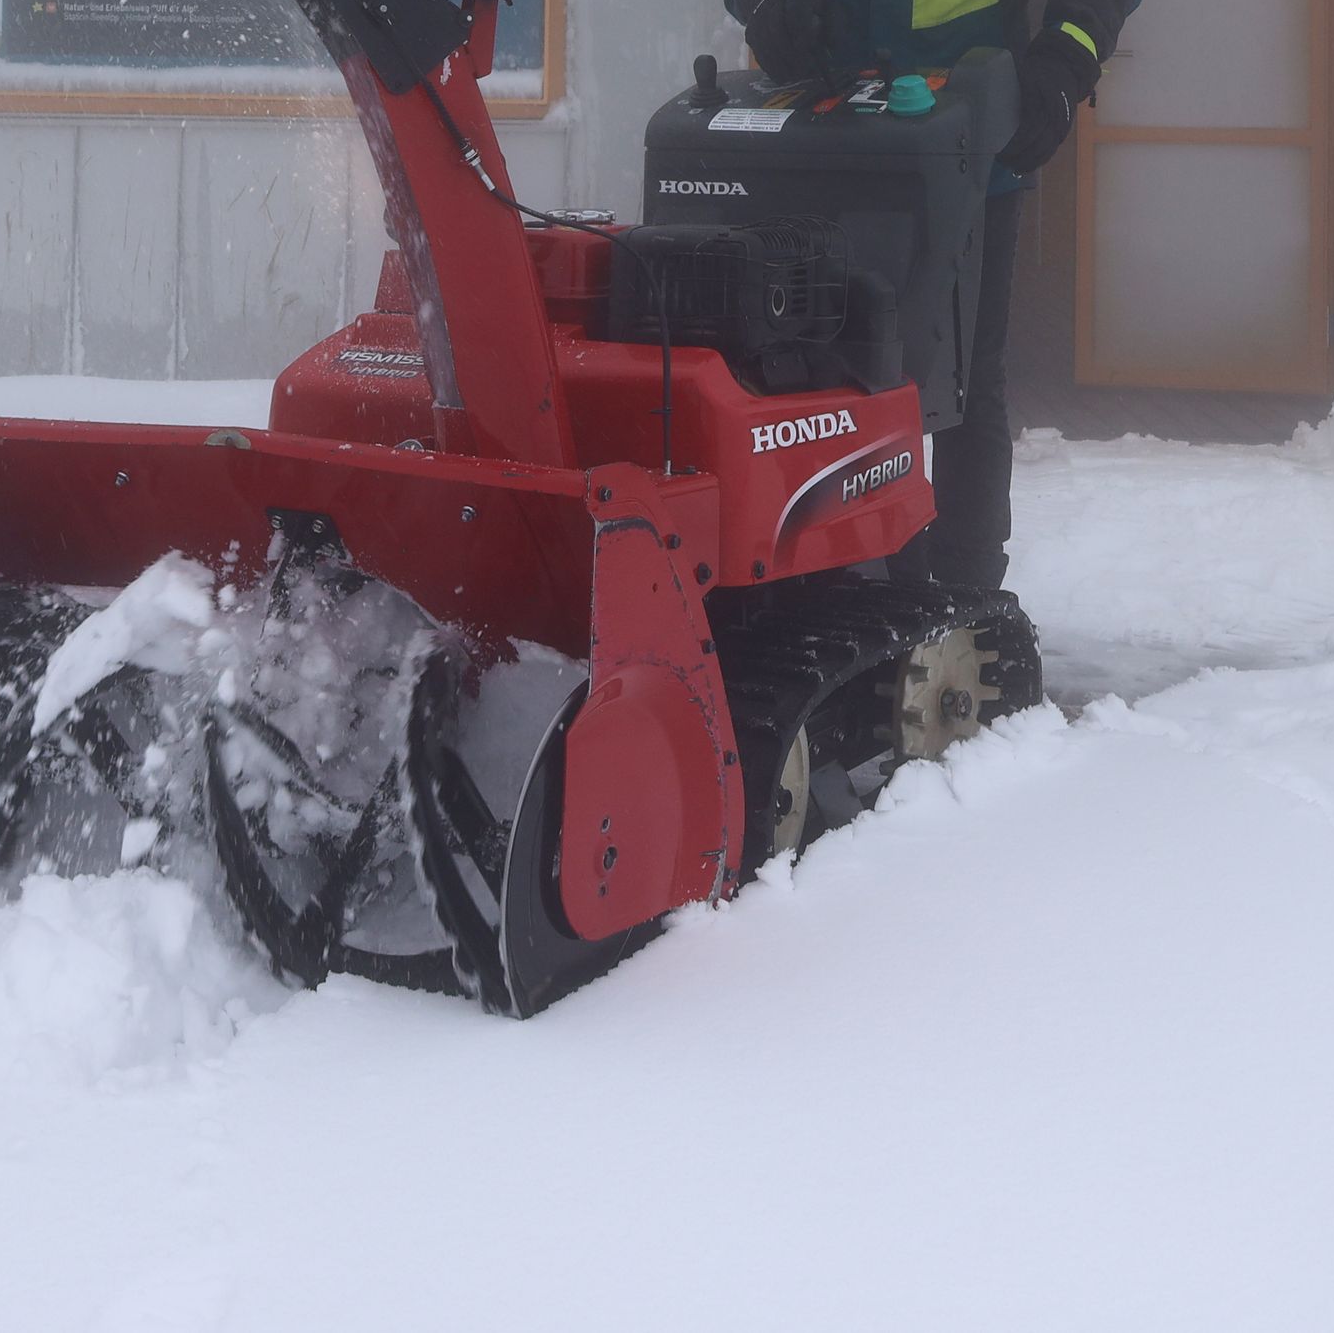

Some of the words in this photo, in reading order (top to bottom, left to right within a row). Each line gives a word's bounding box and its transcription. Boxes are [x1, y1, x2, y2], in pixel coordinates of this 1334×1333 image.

[659, 180, 749, 195] HONDA
[350, 367, 418, 378] HYBRID
[751, 409, 857, 454] HONDA
[842, 451, 913, 502] HYBRID
